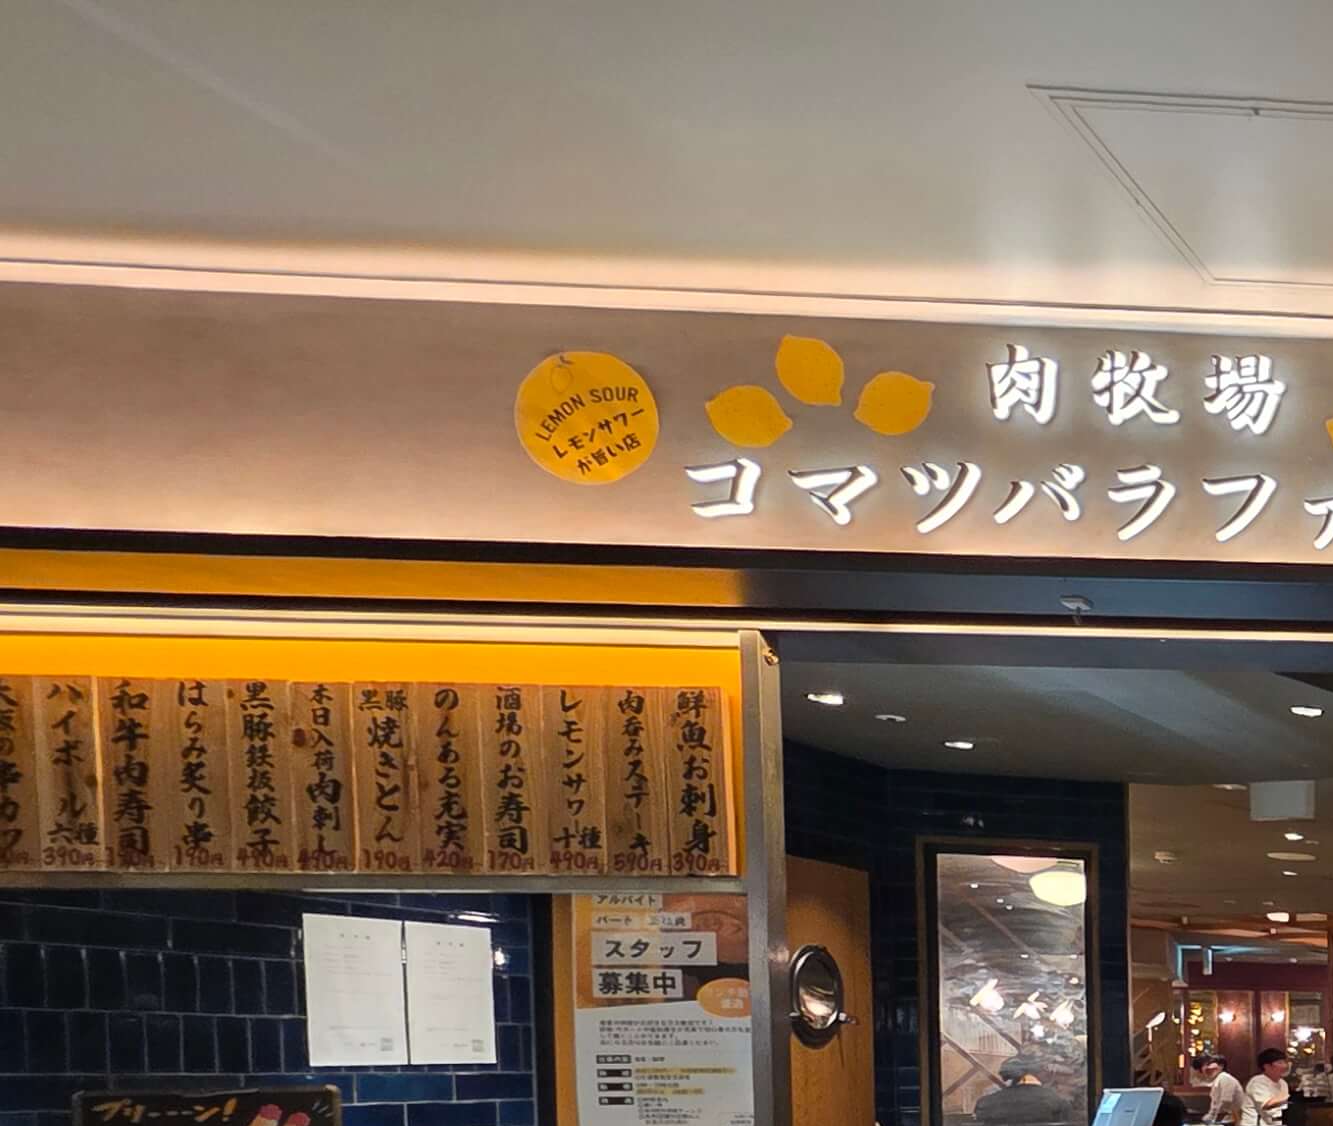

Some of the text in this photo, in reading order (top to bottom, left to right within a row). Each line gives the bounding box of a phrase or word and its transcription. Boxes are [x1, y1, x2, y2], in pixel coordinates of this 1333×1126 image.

[535, 386, 639, 442] LEMON SOUR
[552, 408, 645, 459] レモンサワー
[577, 432, 642, 475] が旨い店
[984, 343, 1288, 438] 肉牧場
[47, 683, 86, 819] ハイボール
[109, 679, 153, 855] 和牛肉寿司
[177, 680, 215, 849] はらみ炙り串
[239, 681, 282, 855] 黒豚鉄板餃子
[367, 715, 404, 844] 焼きとん
[433, 687, 468, 851] のんある充実
[495, 685, 531, 856] 酒場のお寿司
[557, 689, 587, 834] レモンサワー
[617, 688, 652, 856] 肉呑みステーキ
[675, 690, 717, 856] 鮮魚お刺身
[598, 971, 677, 996] 募集中
[605, 938, 703, 960] スタッフ
